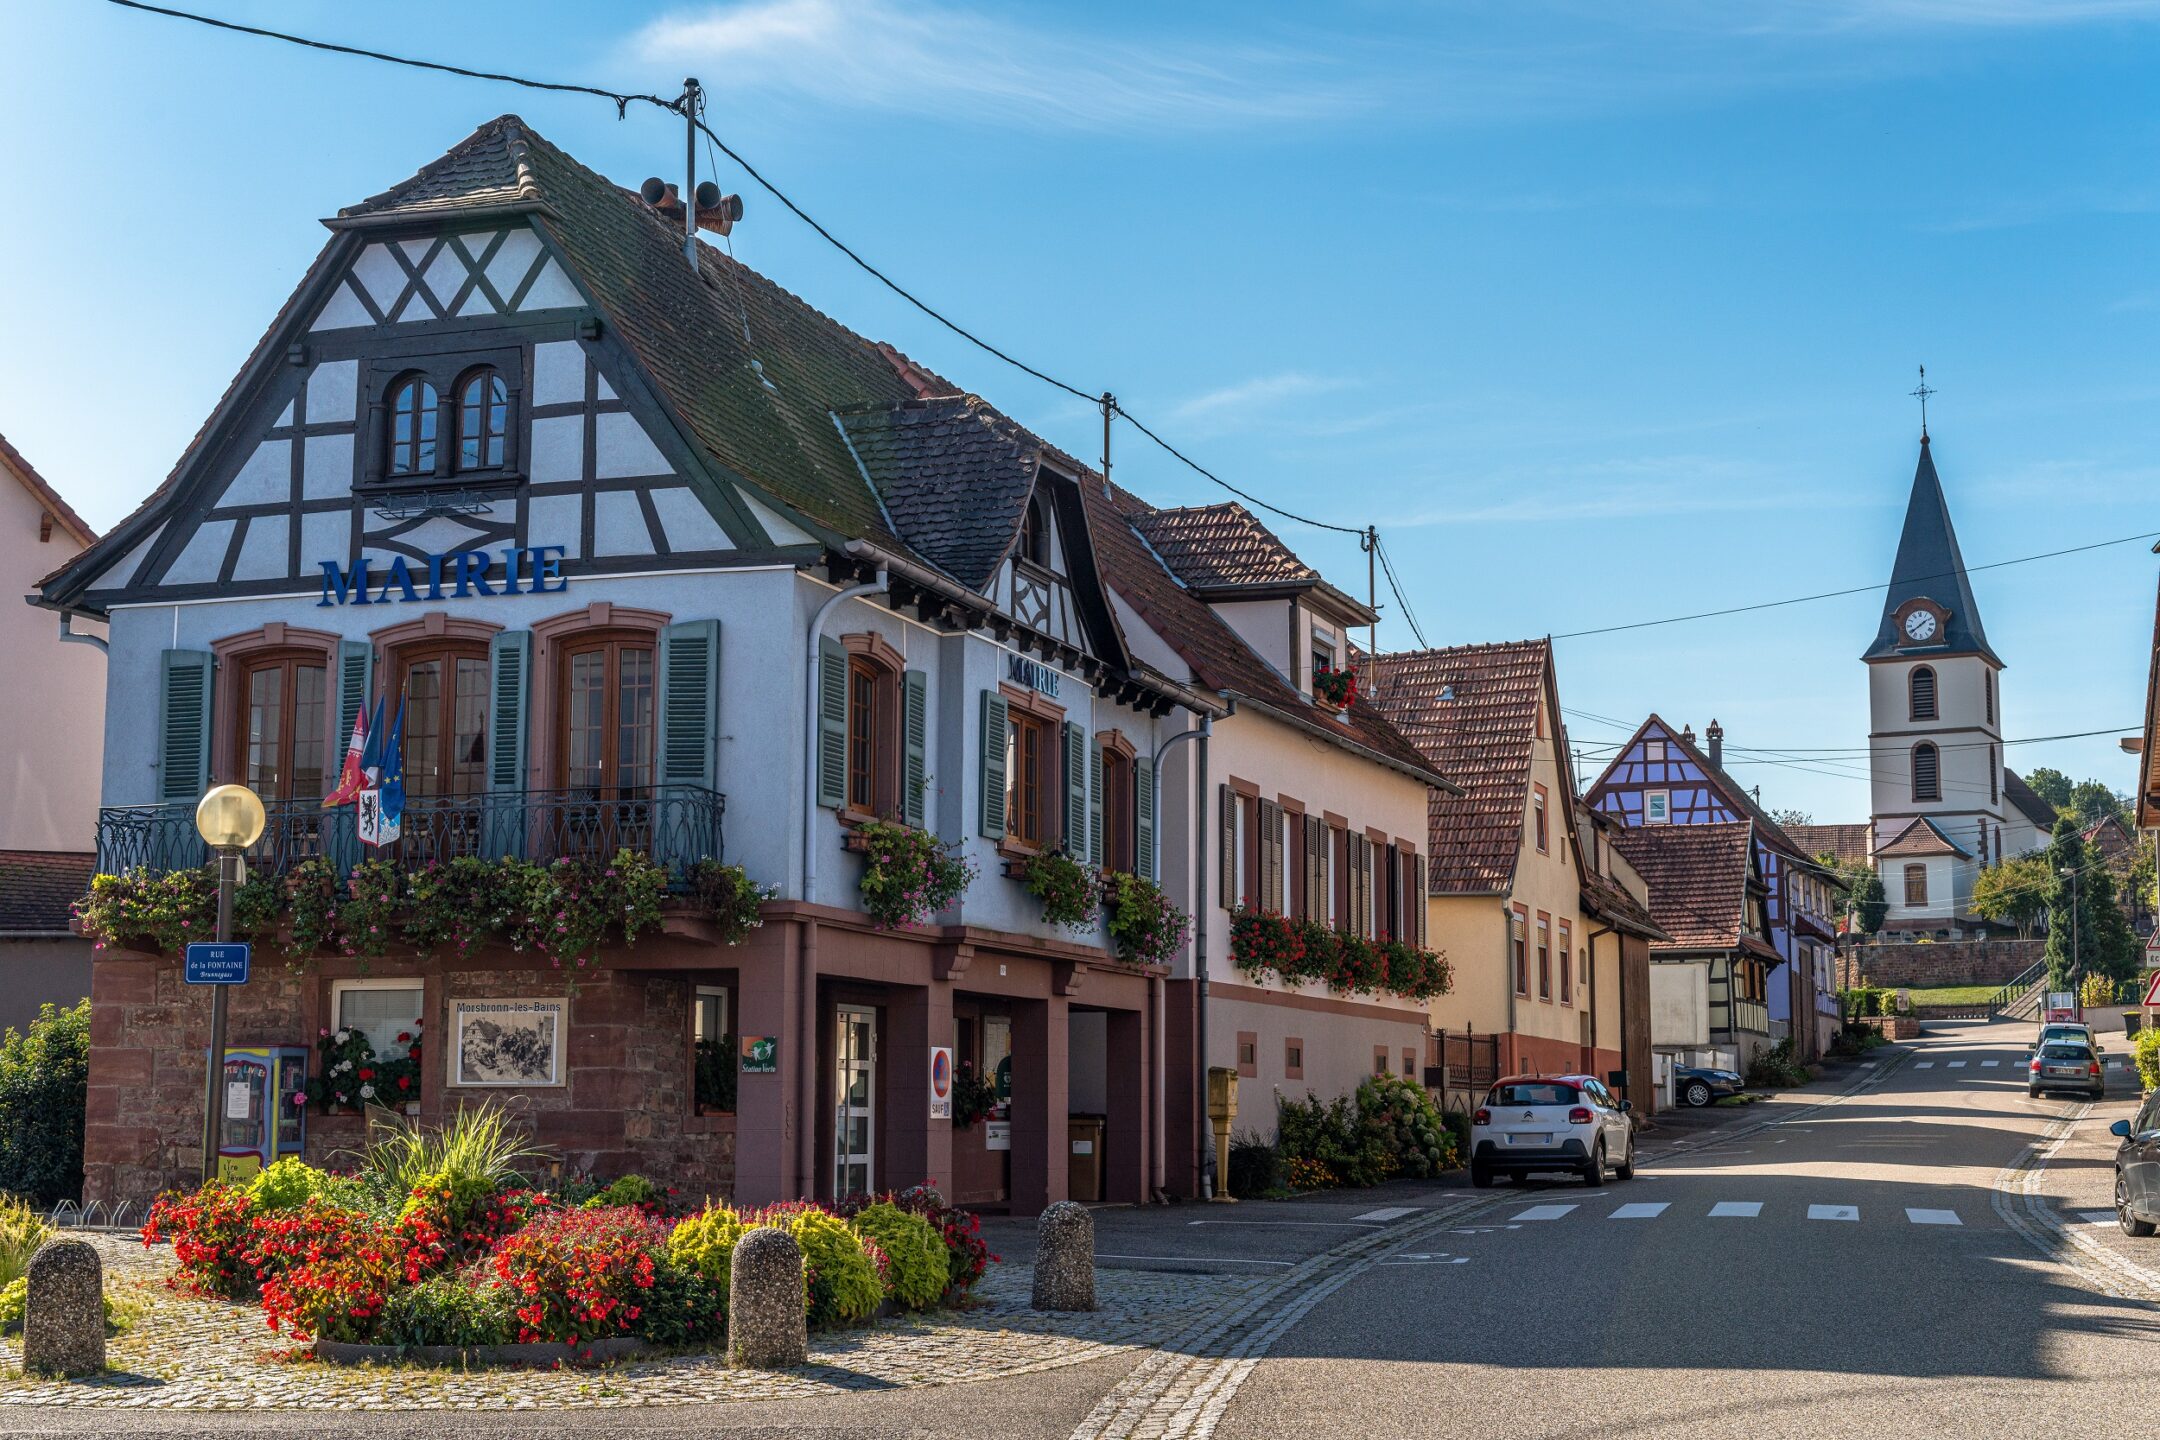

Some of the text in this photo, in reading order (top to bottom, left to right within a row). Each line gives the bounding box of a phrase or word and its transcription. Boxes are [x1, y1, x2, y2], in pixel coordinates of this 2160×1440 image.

[317, 545, 568, 607] MAIRIE
[1008, 653, 1060, 698] MAIRIE
[207, 961, 243, 969] FONTAINE
[457, 1002, 561, 1012] Morsbronn-les-Bains
[932, 1103, 944, 1114] SAUF
